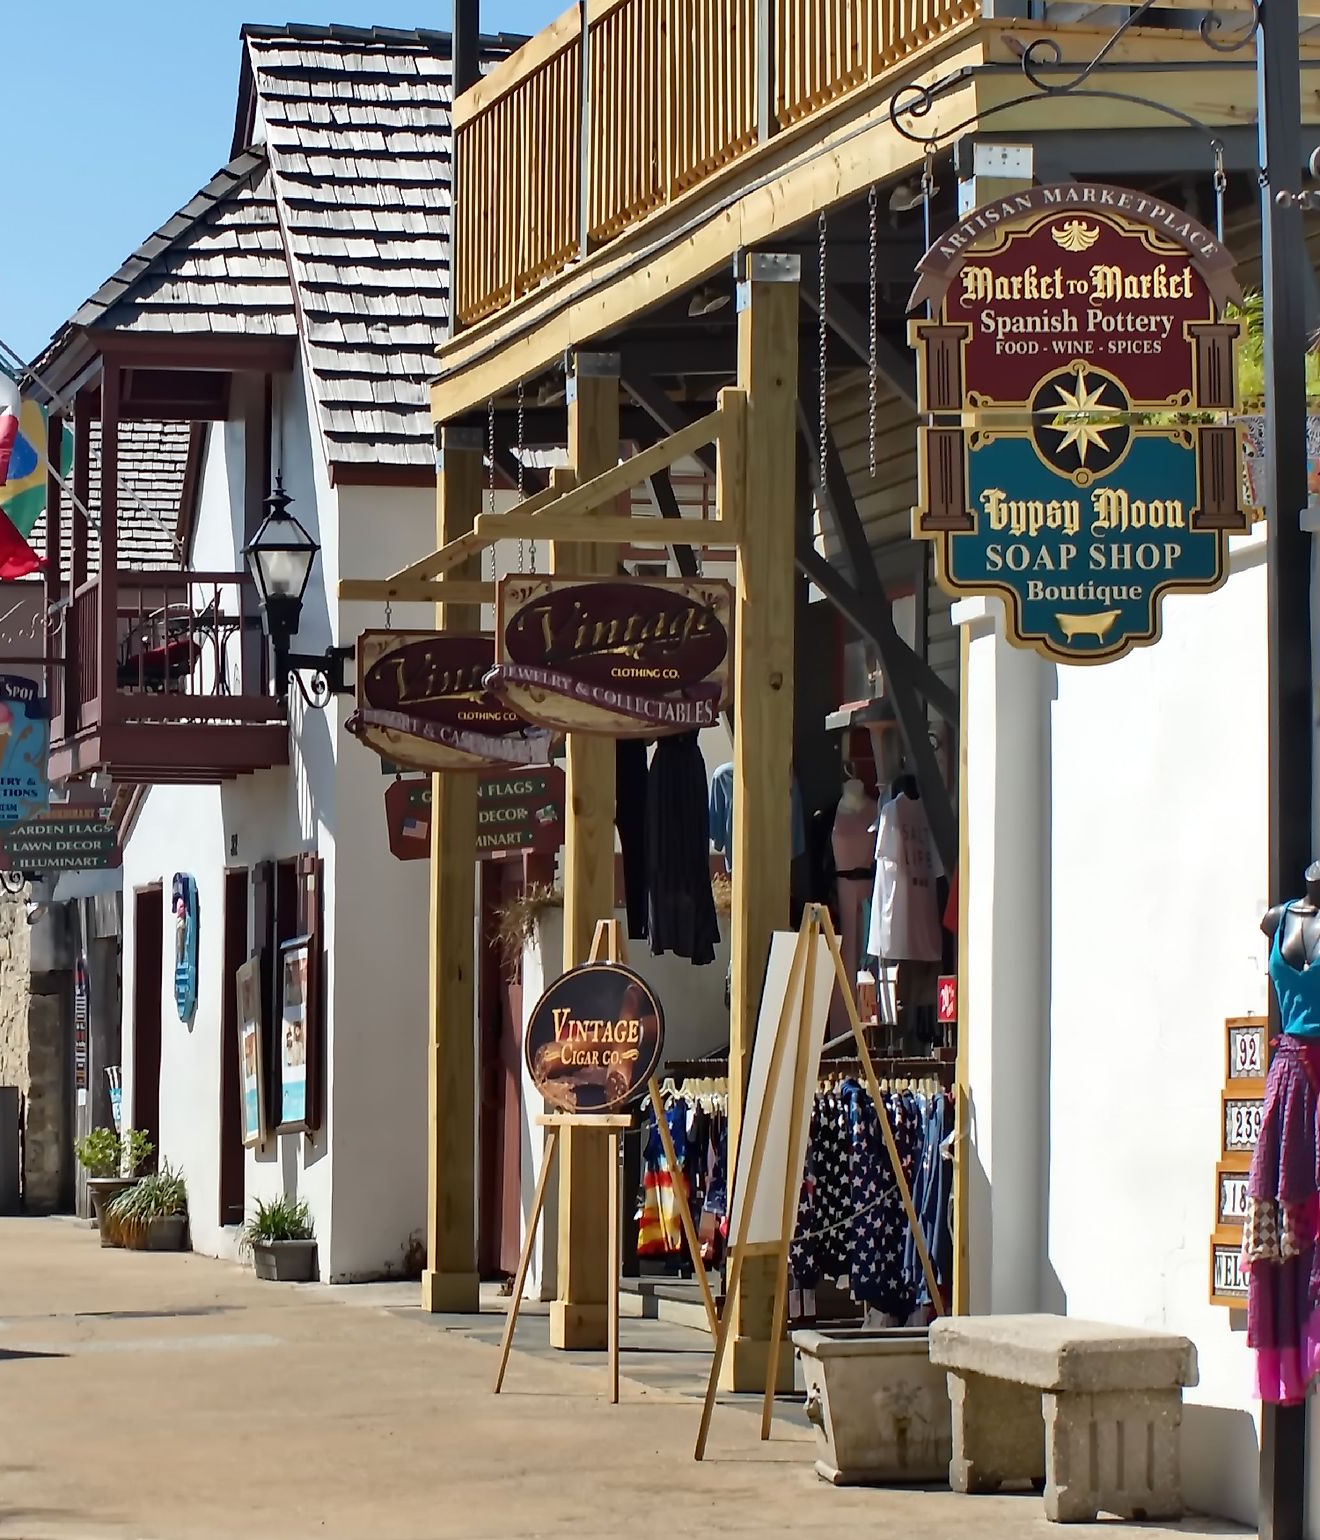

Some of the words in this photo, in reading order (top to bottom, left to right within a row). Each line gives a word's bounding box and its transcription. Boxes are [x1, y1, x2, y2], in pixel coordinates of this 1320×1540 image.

[939, 194, 1032, 259] ARTISAN
[1042, 188, 1219, 259] MARKETPLACE
[959, 265, 1064, 309] Market
[1067, 279, 1088, 295] TO
[1088, 264, 1194, 307] Market
[980, 308, 1078, 339] Spanish
[1086, 308, 1174, 338] Pottery
[995, 340, 1039, 355] FOOD
[1052, 340, 1094, 354] WINE
[1107, 340, 1162, 354] SPICES
[980, 487, 1080, 537] Gypsy
[1090, 487, 1186, 538] Moon
[985, 543, 1077, 571] SOAP
[1089, 543, 1181, 570] SHOP
[1027, 580, 1142, 605] Boutique
[518, 601, 717, 662] Vintage
[610, 667, 661, 679] CLOTHING
[662, 668, 681, 680] CO.
[5, 683, 34, 701] SPOT
[502, 664, 574, 691] JEWELRY
[575, 681, 590, 697] &
[591, 687, 714, 724] COLLECTABLES
[457, 711, 502, 722] CLOTHING
[503, 711, 519, 722] CO.
[488, 781, 533, 797] FLAGS
[479, 808, 526, 823] DECOR
[10, 823, 64, 836] ARDEN
[69, 823, 113, 834] FLAGS
[13, 842, 52, 852] LAWN
[56, 840, 102, 851] DECOR
[20, 856, 99, 869] ILLUMINART
[551, 1007, 640, 1043] VINTAGE
[560, 1043, 600, 1065] CIGAR
[1239, 1037, 1257, 1067] 92
